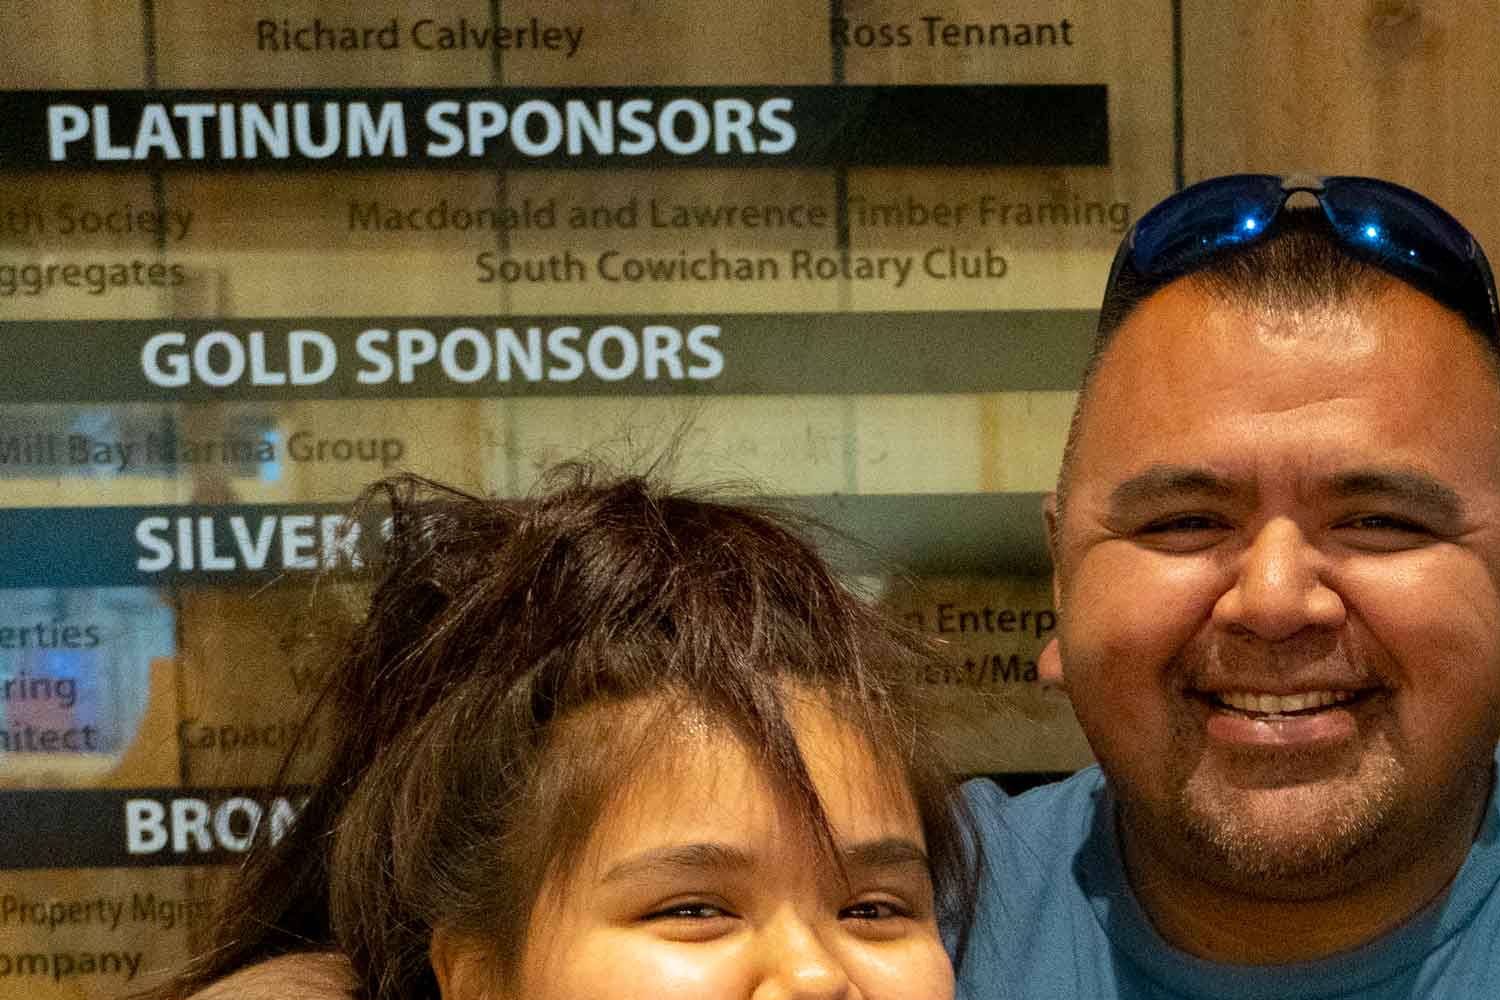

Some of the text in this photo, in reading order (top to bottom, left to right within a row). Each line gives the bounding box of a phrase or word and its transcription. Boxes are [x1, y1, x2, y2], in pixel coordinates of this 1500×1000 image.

[258, 19, 584, 58] Richard Calverley
[831, 16, 1073, 48] Ross Tennant
[47, 98, 797, 161] PLATINUM SPONSORS
[348, 197, 1130, 234] Macdonald and Lawrence Framing
[476, 248, 1007, 287] South Cowichan Rotary Club
[141, 325, 724, 387] GOLD SPONSORS
[287, 430, 404, 468] Group
[135, 514, 363, 572] SILVER
